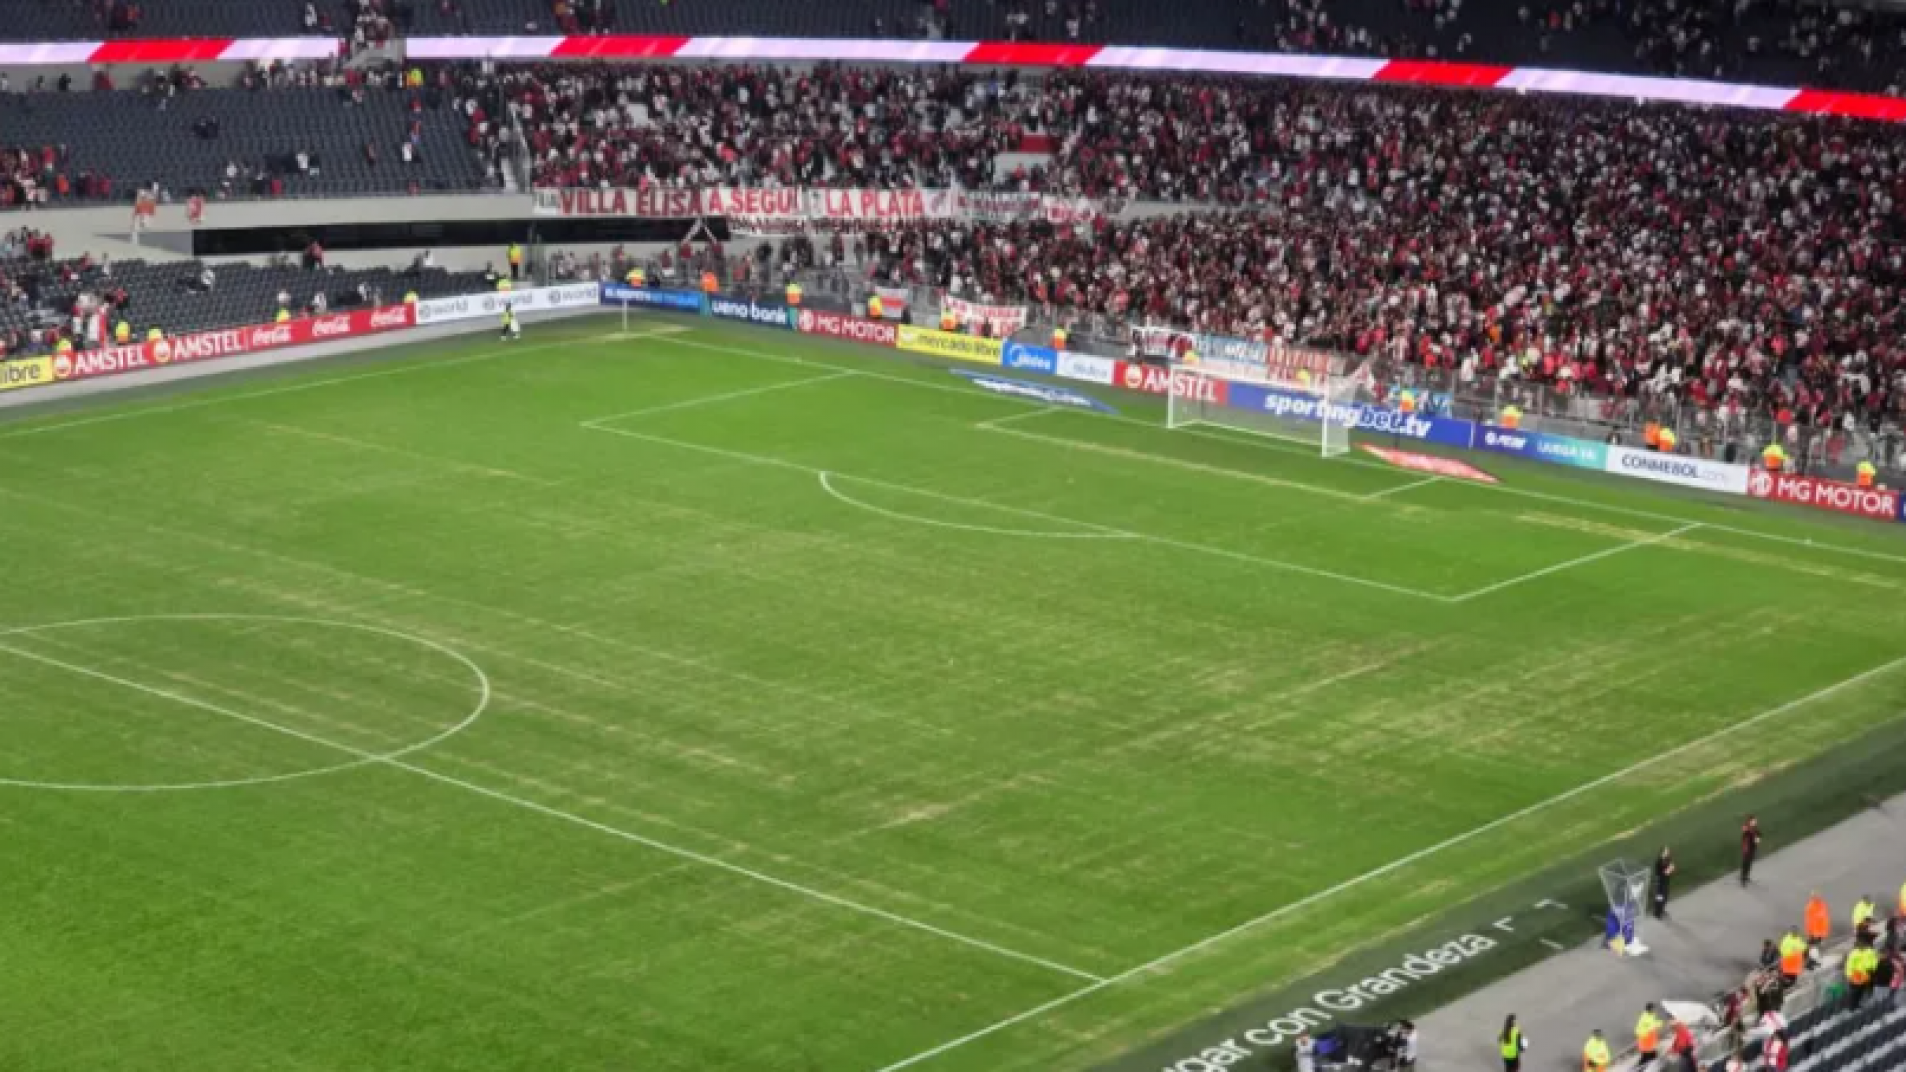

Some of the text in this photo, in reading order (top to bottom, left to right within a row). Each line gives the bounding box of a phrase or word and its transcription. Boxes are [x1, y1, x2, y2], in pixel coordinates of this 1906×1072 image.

[561, 190, 627, 215] VILLA
[636, 190, 702, 216] ELISA
[708, 187, 724, 214] A
[825, 189, 855, 217] LA
[861, 189, 924, 217] PLATA
[712, 299, 787, 325] ueno bank
[818, 315, 895, 343] MG MOTOR
[75, 346, 149, 375] AMSTEL
[174, 330, 242, 361] AMSTEL
[1777, 477, 1895, 517] MG MOTOR
[1244, 1007, 1333, 1046] con
[1314, 933, 1498, 1012] Grandeza
